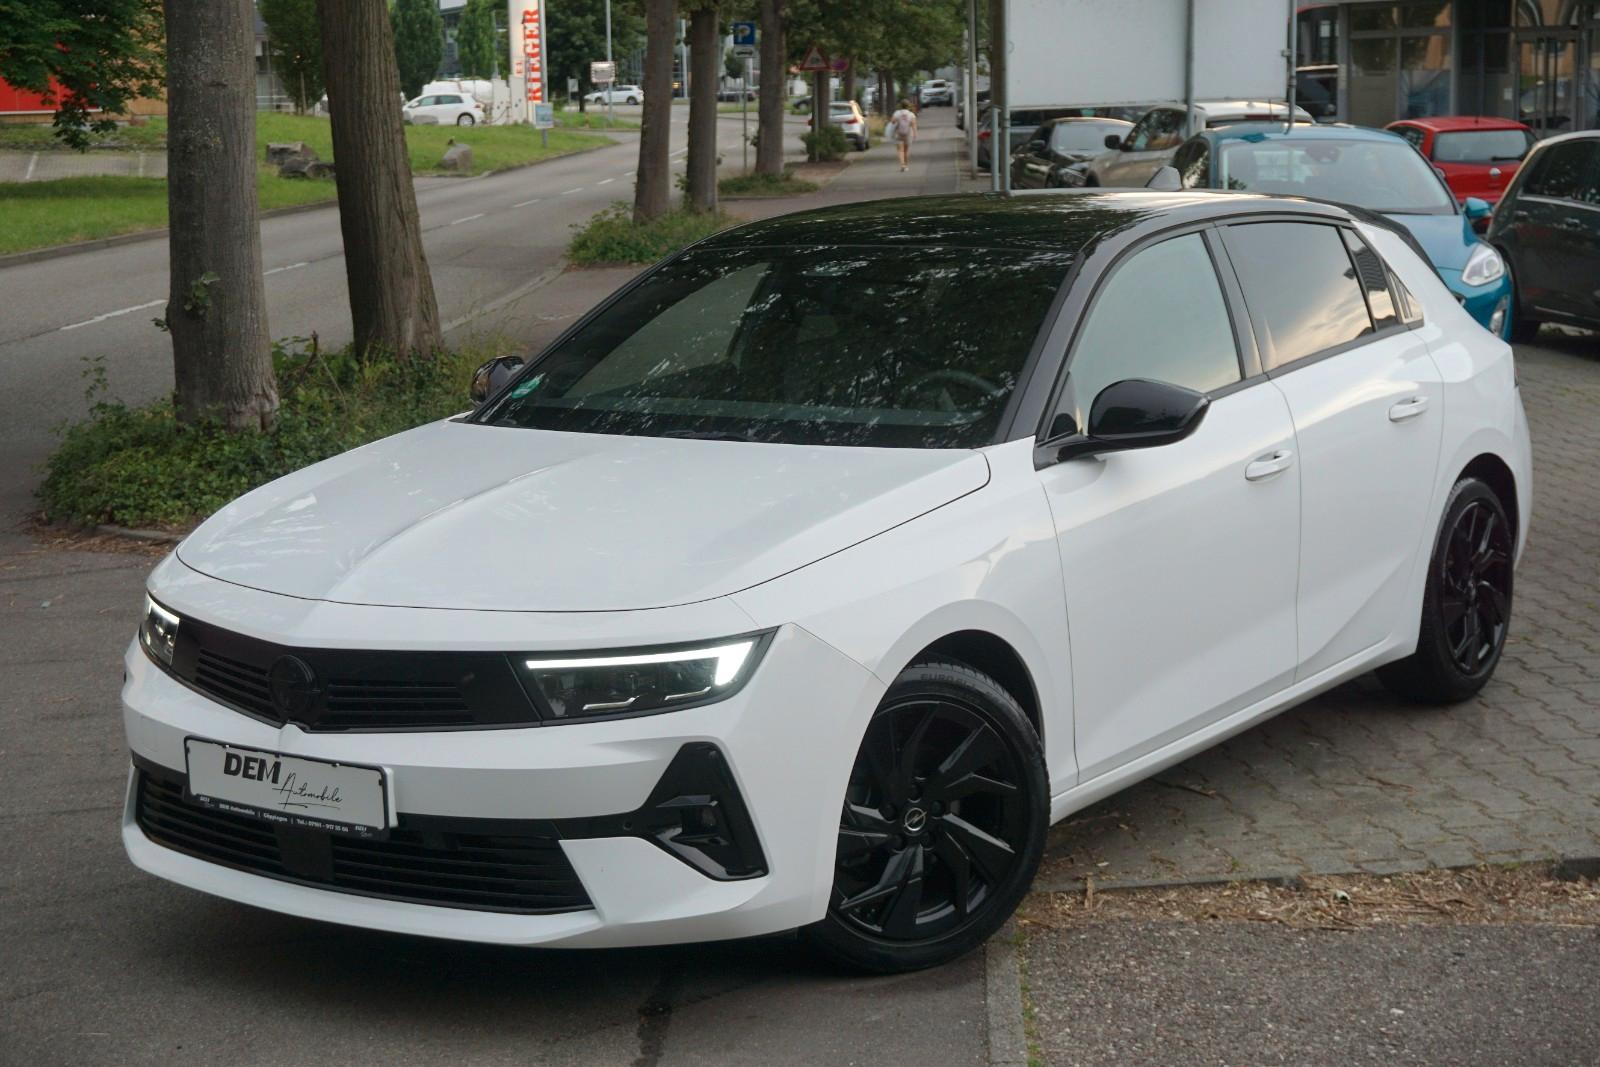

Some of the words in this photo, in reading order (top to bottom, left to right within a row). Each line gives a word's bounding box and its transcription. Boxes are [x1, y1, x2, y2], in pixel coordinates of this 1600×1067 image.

[738, 25, 751, 43] P
[224, 752, 281, 784] DEM
[272, 772, 343, 809] Automobile
